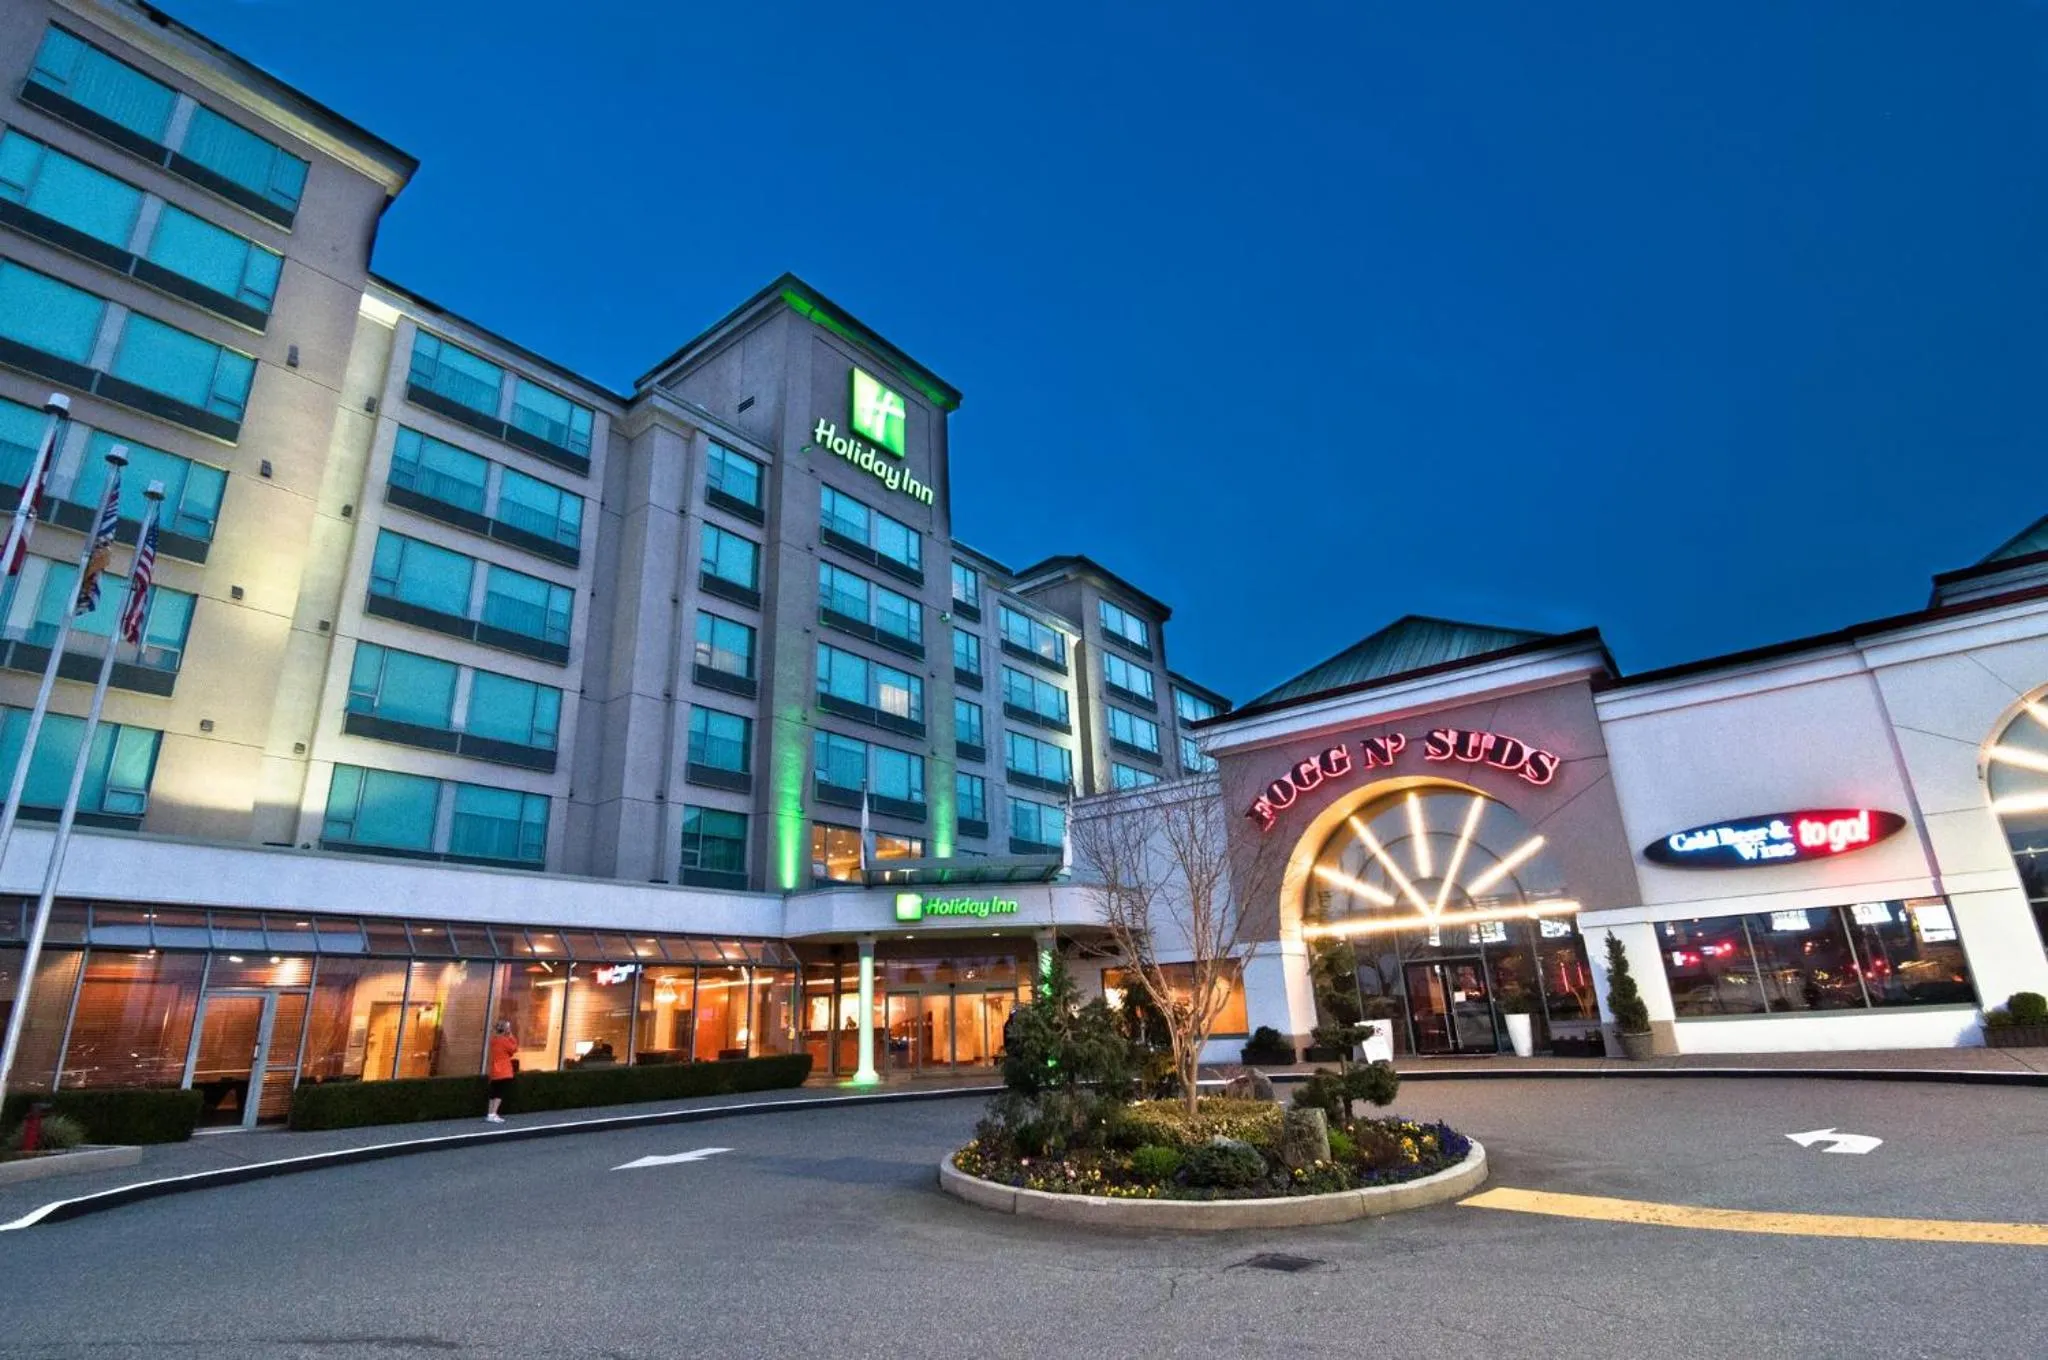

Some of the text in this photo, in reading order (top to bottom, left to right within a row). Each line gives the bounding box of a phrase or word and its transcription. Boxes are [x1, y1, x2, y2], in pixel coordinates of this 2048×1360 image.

[814, 417, 934, 506] Holiday Inn
[1246, 744, 1353, 831] FOGG
[1425, 728, 1561, 785] SUDS
[1798, 819, 1827, 847] to
[925, 895, 1018, 918] Holiday Inn
